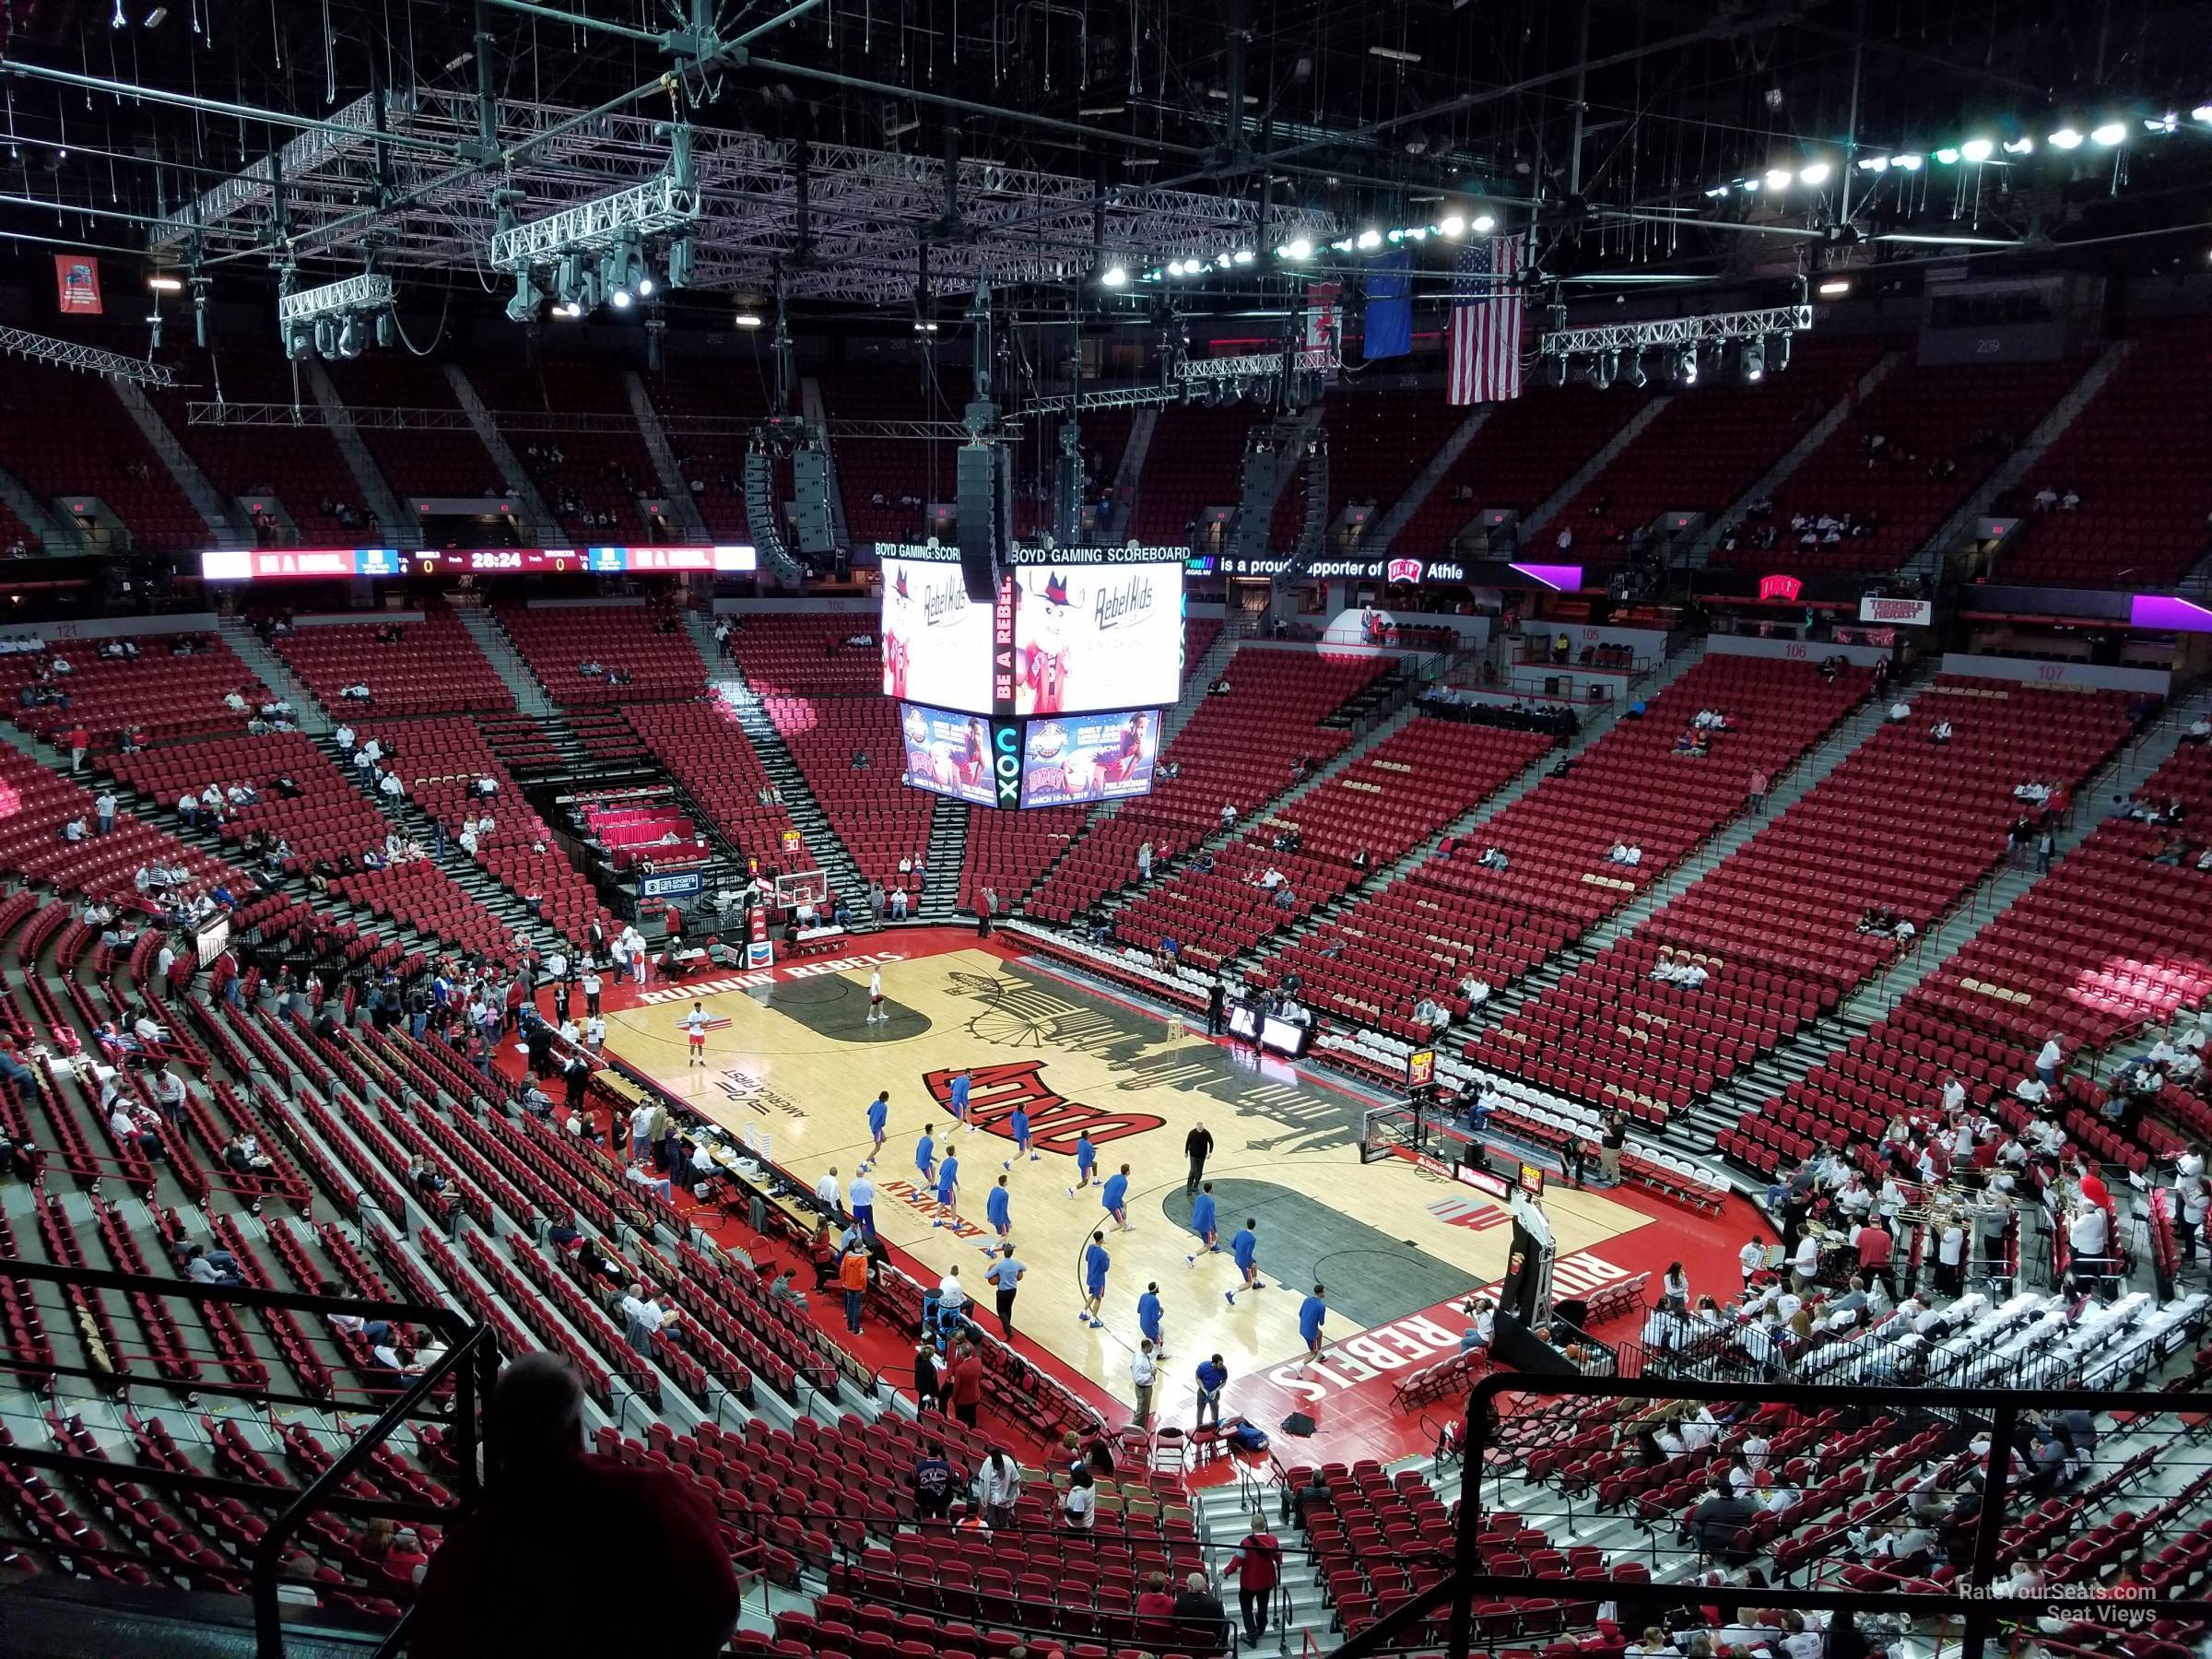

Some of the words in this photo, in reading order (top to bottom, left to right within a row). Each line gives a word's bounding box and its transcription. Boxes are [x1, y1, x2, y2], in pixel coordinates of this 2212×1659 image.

[1977, 339, 2000, 353] 209
[876, 542, 897, 557] BOYD
[899, 544, 932, 559] GAMING
[1011, 549, 1046, 563] BOYD
[1051, 548, 1102, 562] GAMING
[1107, 547, 1191, 562] SCOREBOARD
[424, 559, 433, 573] 0
[472, 552, 522, 569] 28:24
[556, 559, 565, 571] 0
[1220, 557, 1233, 571] is
[1237, 560, 1246, 571] a
[1368, 560, 1382, 576] of
[1428, 562, 1463, 579] Athle
[996, 575, 1012, 644] REBEL.
[1583, 629, 1599, 641] 105
[1785, 644, 1806, 658] 106
[996, 652, 1012, 668] A
[2038, 664, 2065, 681] 107
[996, 674, 1012, 700] BE
[996, 728, 1019, 800] COX
[1028, 795, 1052, 805] MARCH
[785, 840, 799, 852] 30
[660, 882, 690, 891] NETWORK
[782, 951, 905, 979] REBELS
[721, 1069, 760, 1088] FIRST
[753, 1087, 810, 1118] AMERICA
[1269, 1314, 1469, 1402] REBELS
